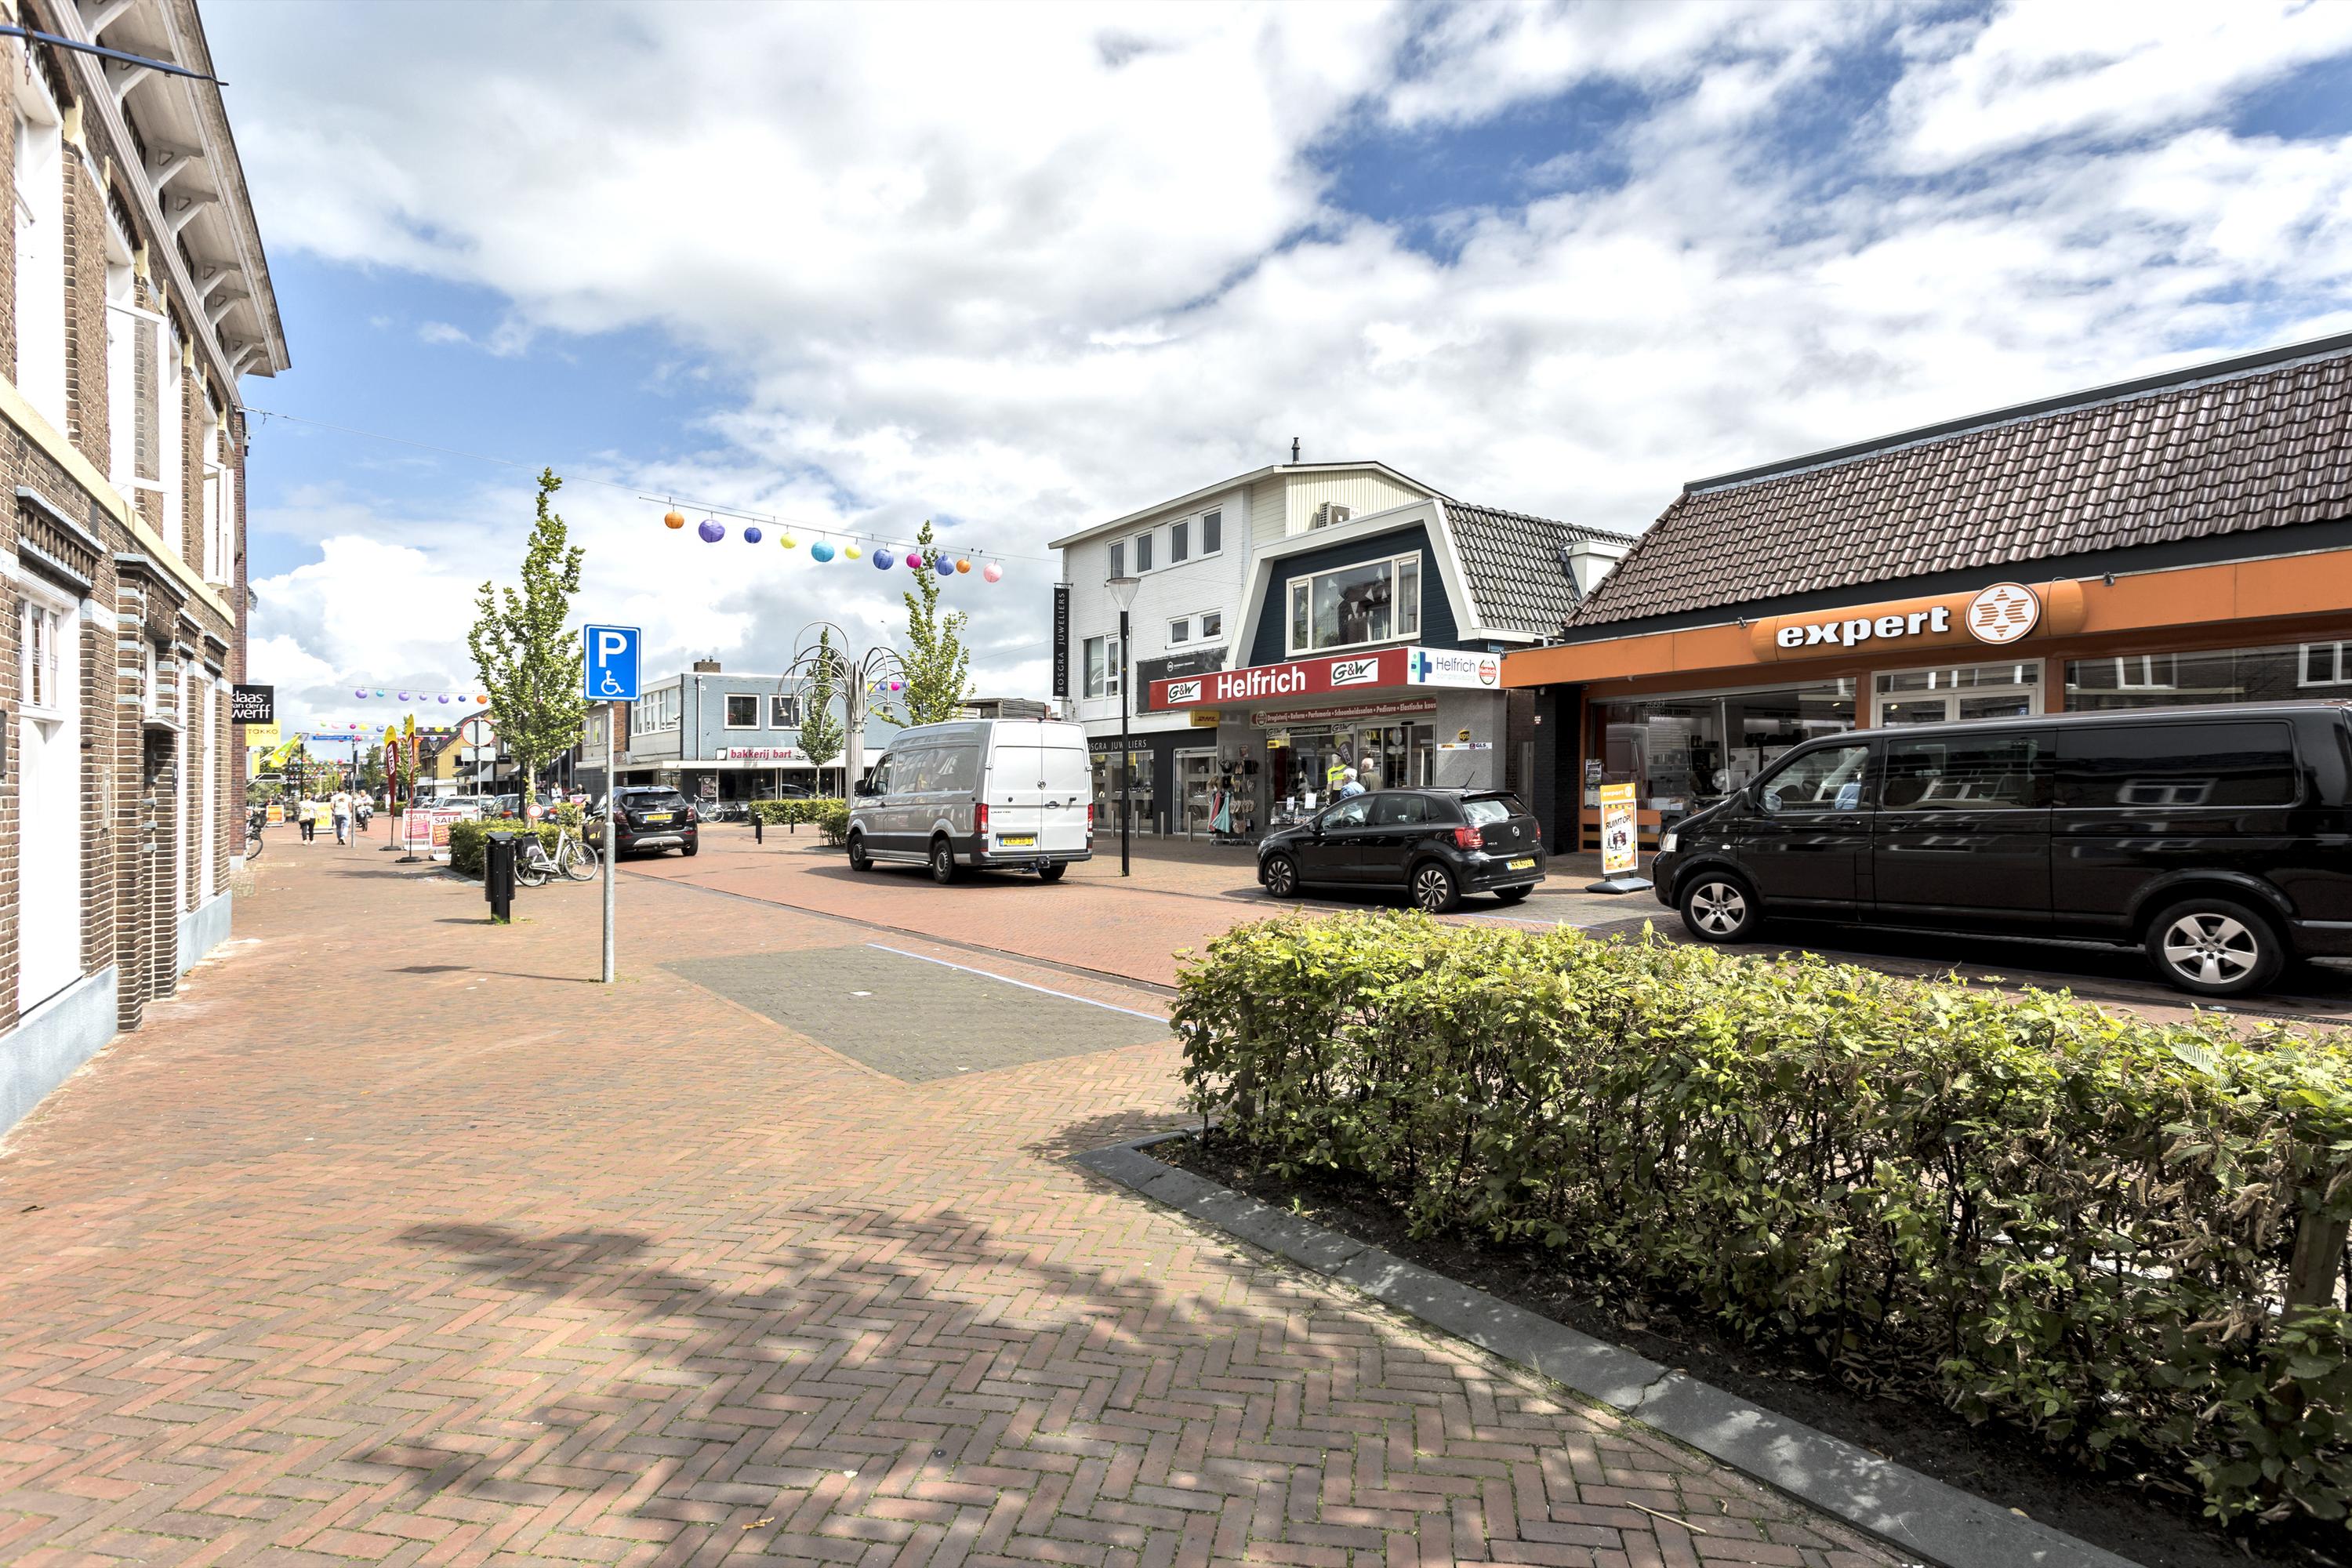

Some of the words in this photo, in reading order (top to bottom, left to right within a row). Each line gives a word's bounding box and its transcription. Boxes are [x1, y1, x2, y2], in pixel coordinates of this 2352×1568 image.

[1777, 606, 1950, 648] expert
[598, 631, 627, 668] P
[1436, 657, 1475, 673] Helfrich
[1218, 666, 1305, 699] Helfrich
[1268, 713, 1287, 722] Drogisterij
[1308, 710, 1331, 718] Parfumerie
[1376, 705, 1396, 713] Pedicure
[1400, 702, 1423, 711] Elastische
[731, 750, 770, 760] bakkerij
[773, 750, 792, 759] bart
[1087, 742, 1107, 751] OSGRA
[1111, 739, 1147, 751] JUWLIERS
